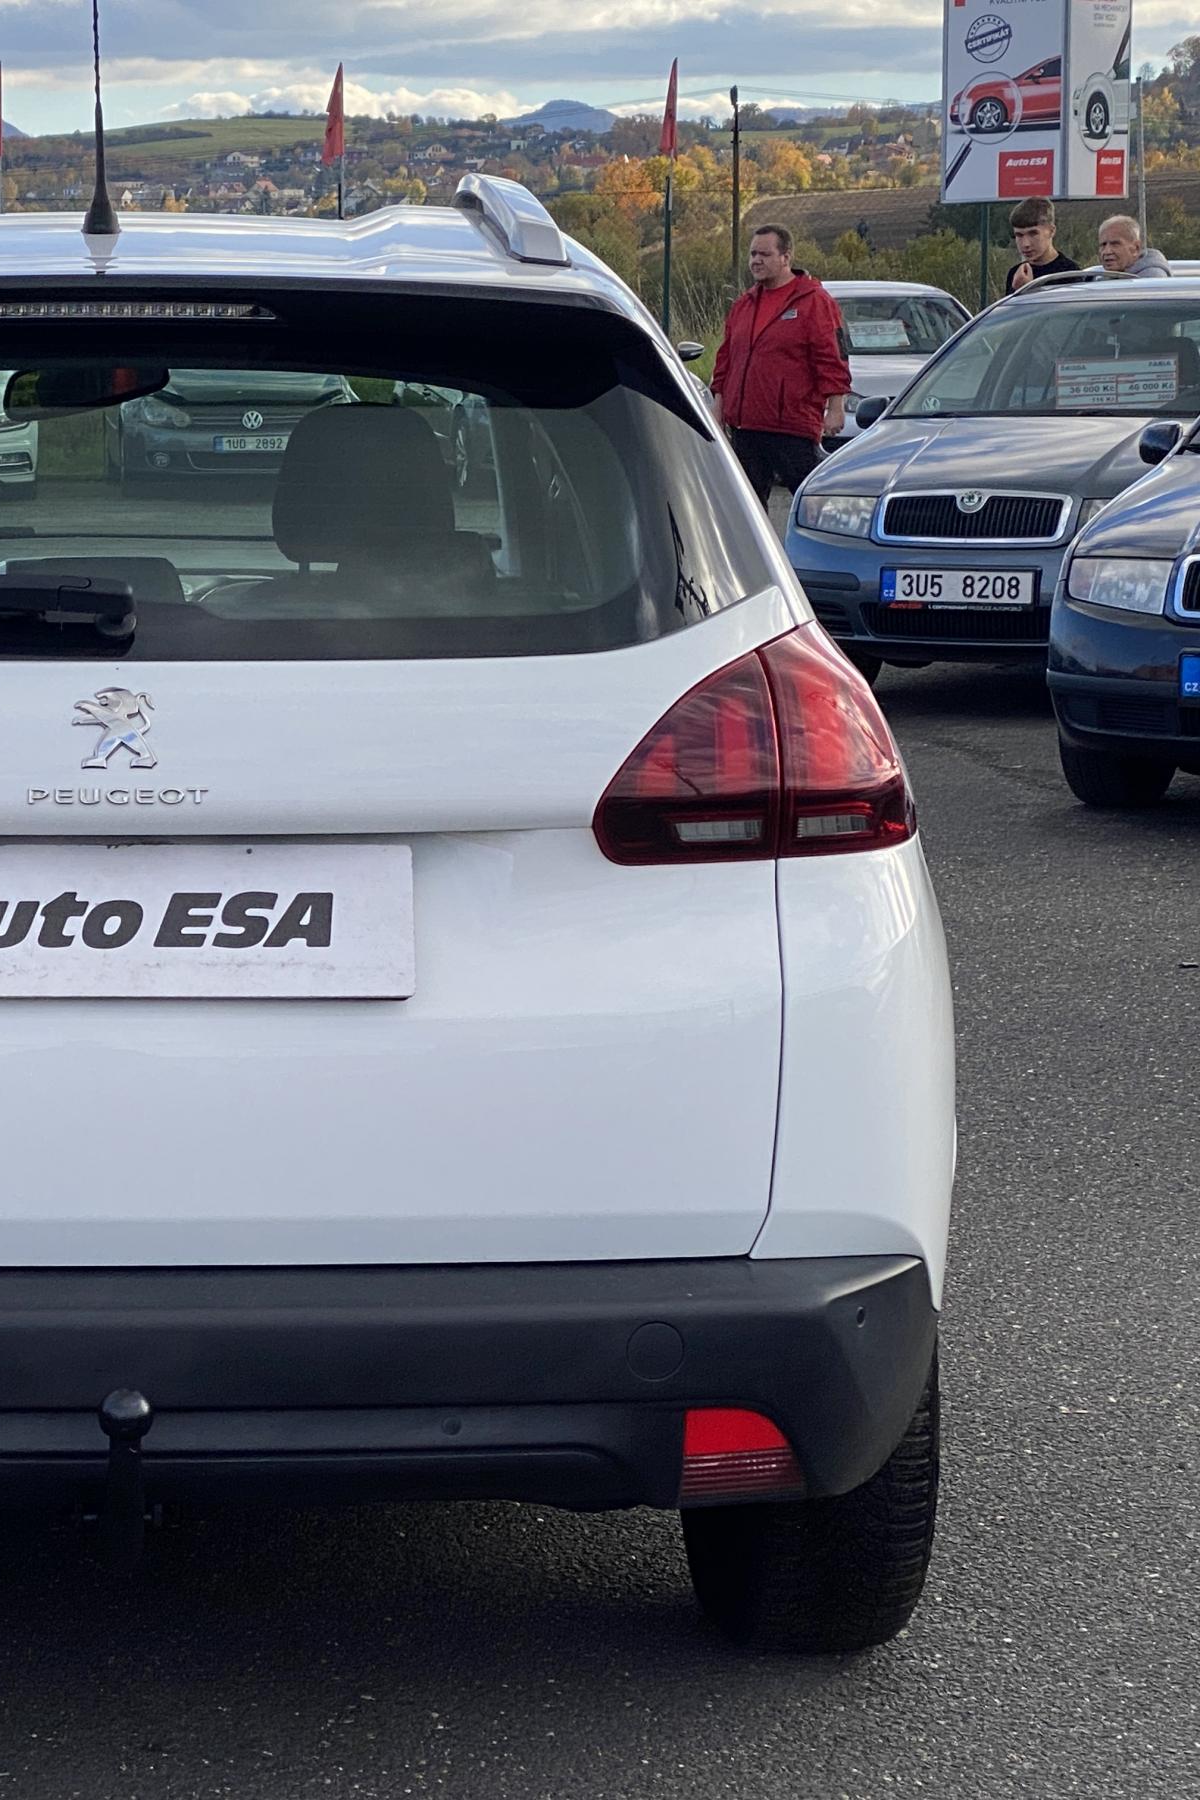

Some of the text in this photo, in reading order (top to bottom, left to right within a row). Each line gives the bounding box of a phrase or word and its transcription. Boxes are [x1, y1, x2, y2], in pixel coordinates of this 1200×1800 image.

[967, 27, 1010, 49] CERTIFIKÁT
[1005, 157, 1048, 167] Auto ESA
[1084, 385, 1100, 393] 000
[1142, 382, 1159, 390] 000
[256, 437, 283, 449] 2892
[901, 573, 1020, 600] 3U5 8208
[883, 589, 895, 597] CZ
[1184, 681, 1199, 692] CZ
[27, 787, 209, 806] PEUGEOT
[153, 891, 334, 949] ESA
